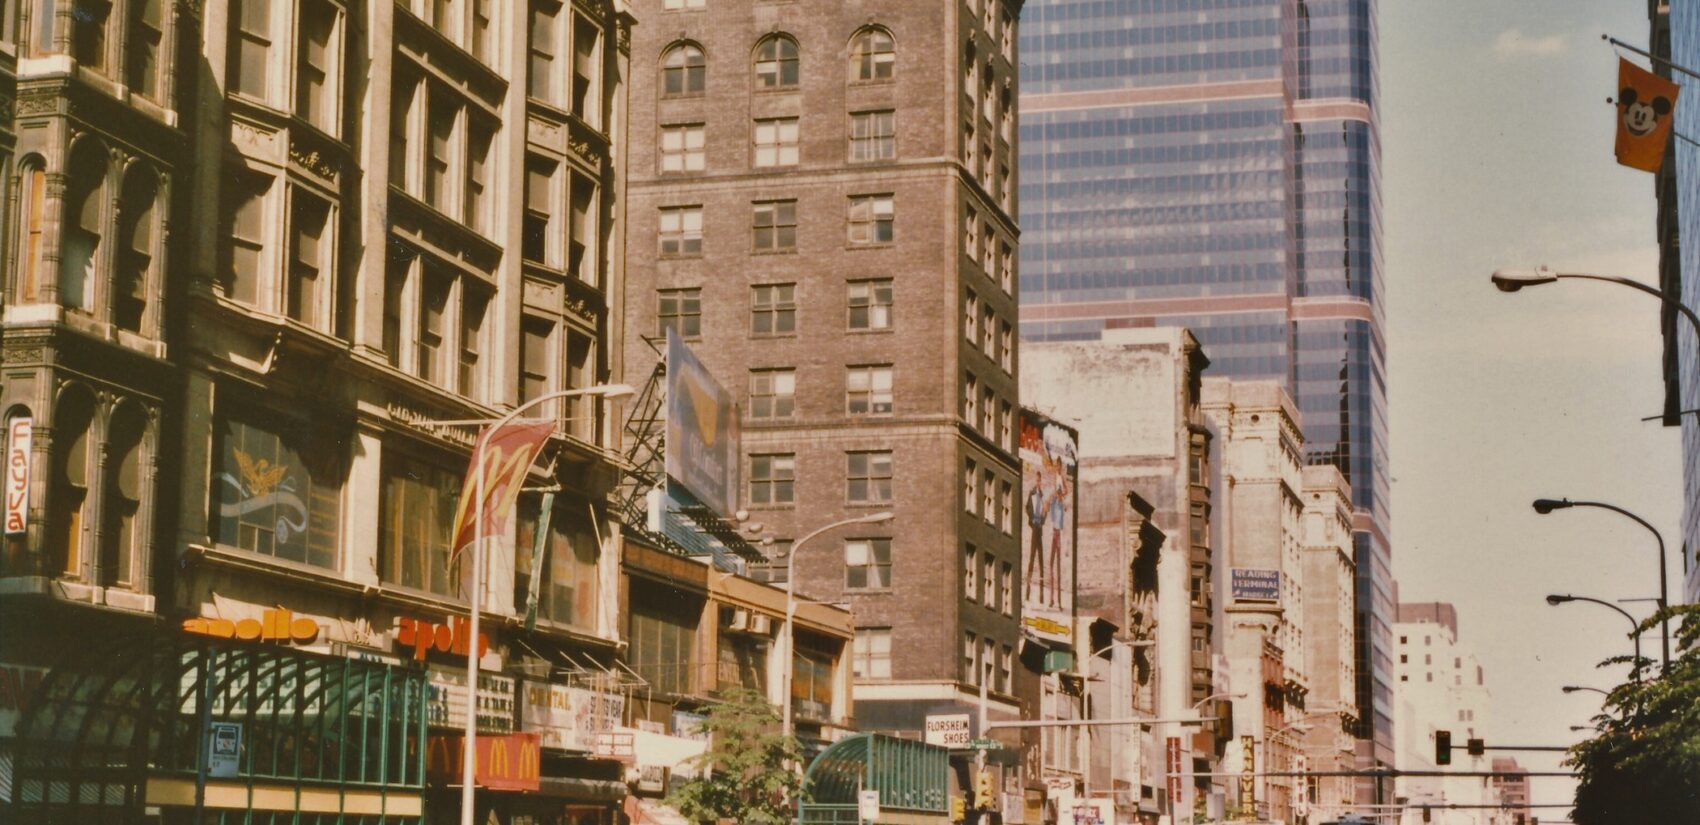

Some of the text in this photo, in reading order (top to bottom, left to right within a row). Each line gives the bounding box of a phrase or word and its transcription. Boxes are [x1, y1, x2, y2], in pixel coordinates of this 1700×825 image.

[8, 421, 30, 531] Fayva
[1235, 570, 1276, 579] READING
[1233, 580, 1277, 588] TERMINAL
[182, 608, 319, 641] apollo
[927, 720, 969, 731] FLORSHEIM
[944, 733, 969, 744] SHOES
